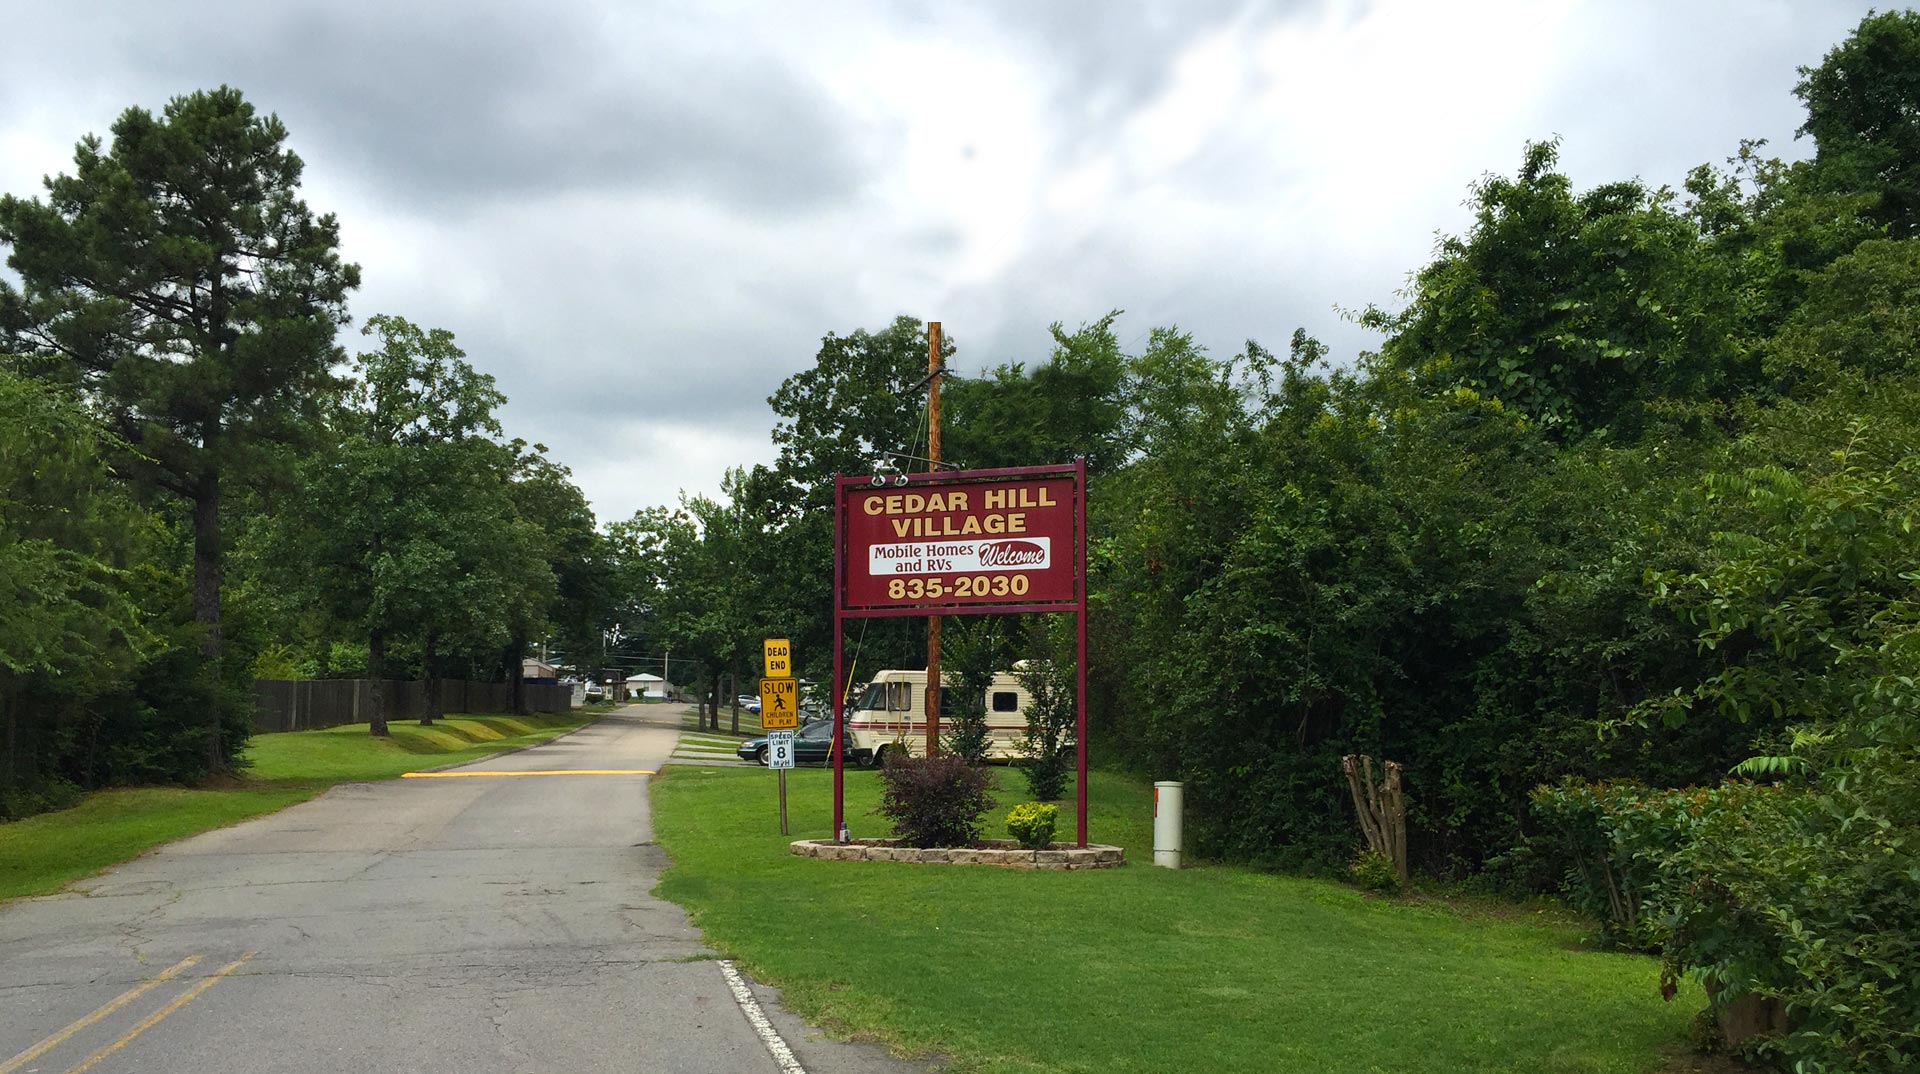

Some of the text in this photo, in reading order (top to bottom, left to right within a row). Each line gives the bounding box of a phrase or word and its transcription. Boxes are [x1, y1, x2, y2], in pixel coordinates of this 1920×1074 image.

[863, 487, 1057, 516] CEDAR HILL
[891, 513, 1027, 538] VILLAGE
[874, 543, 974, 559] Mobile Homes
[979, 542, 1044, 566] Welcome
[895, 558, 952, 573] and RVs
[888, 574, 1029, 600] 835-2030
[767, 647, 788, 657] DEAD
[770, 660, 786, 670] END
[763, 682, 794, 694] SLOW
[776, 746, 786, 759] 8
